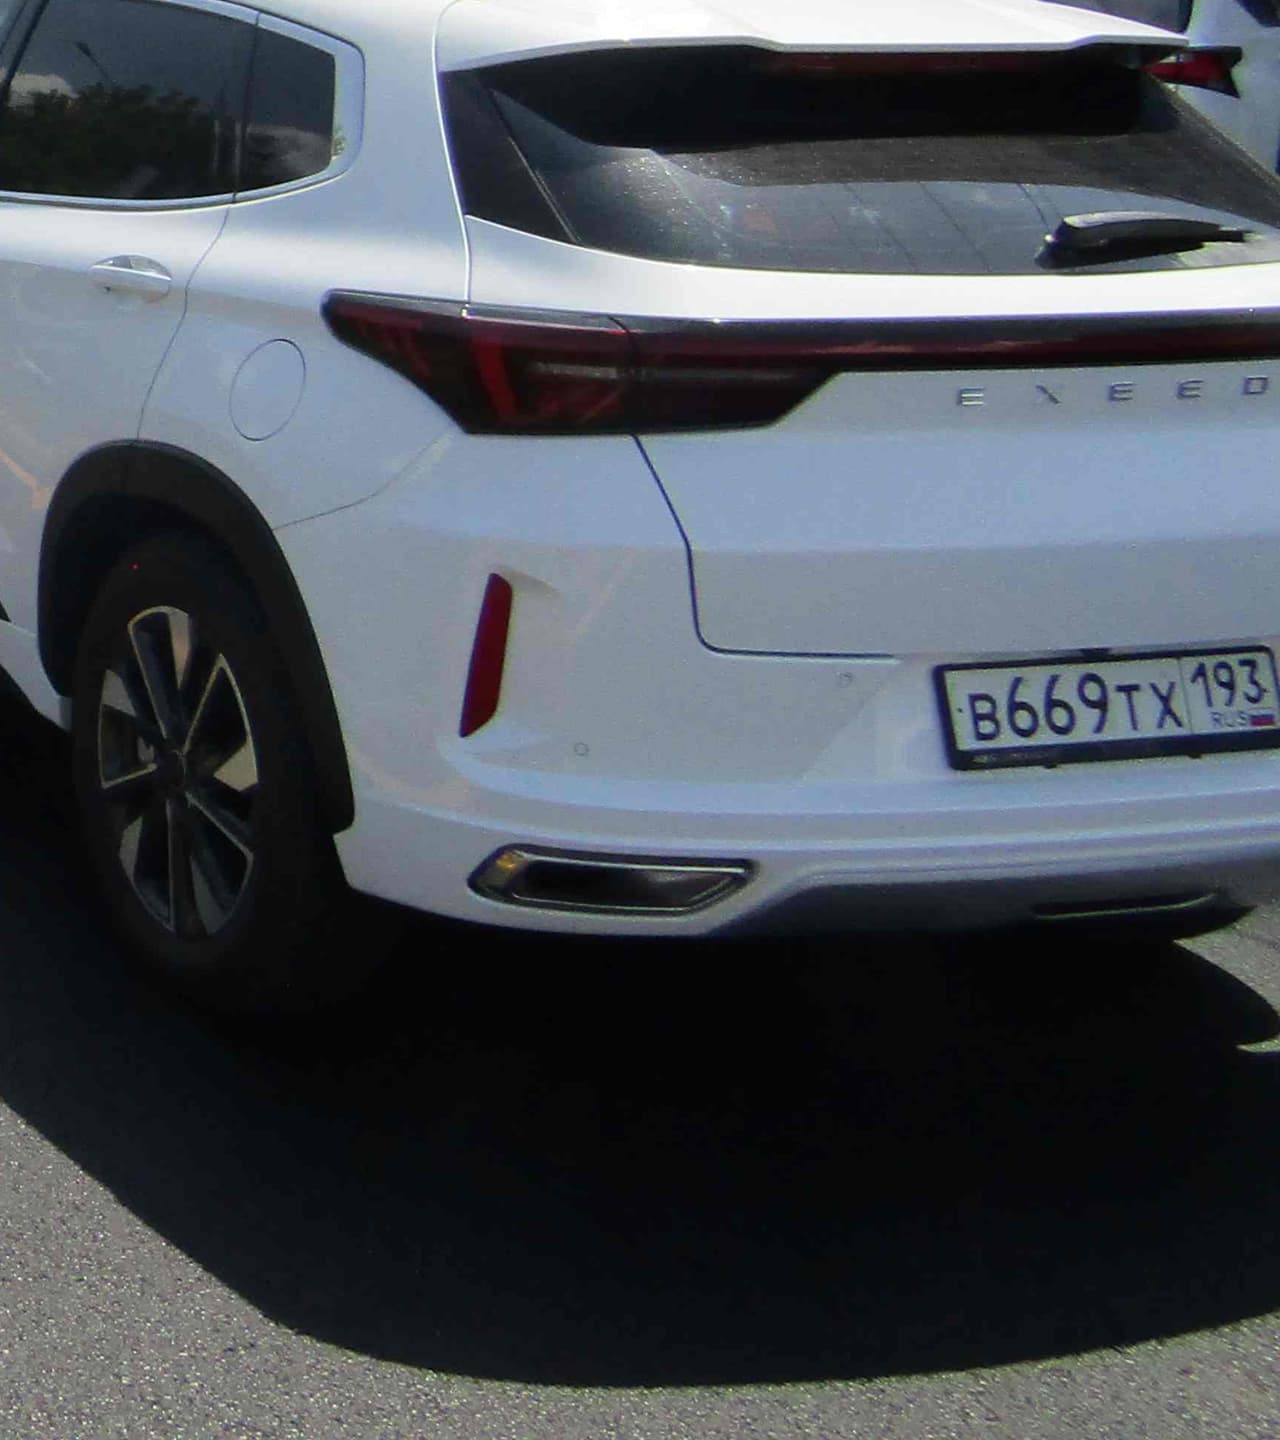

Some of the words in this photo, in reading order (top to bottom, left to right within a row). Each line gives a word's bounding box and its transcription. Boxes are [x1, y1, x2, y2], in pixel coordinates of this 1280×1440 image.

[957, 376, 1269, 407] EXEED
[1190, 658, 1268, 707] 193
[1211, 710, 1249, 729] RUS
